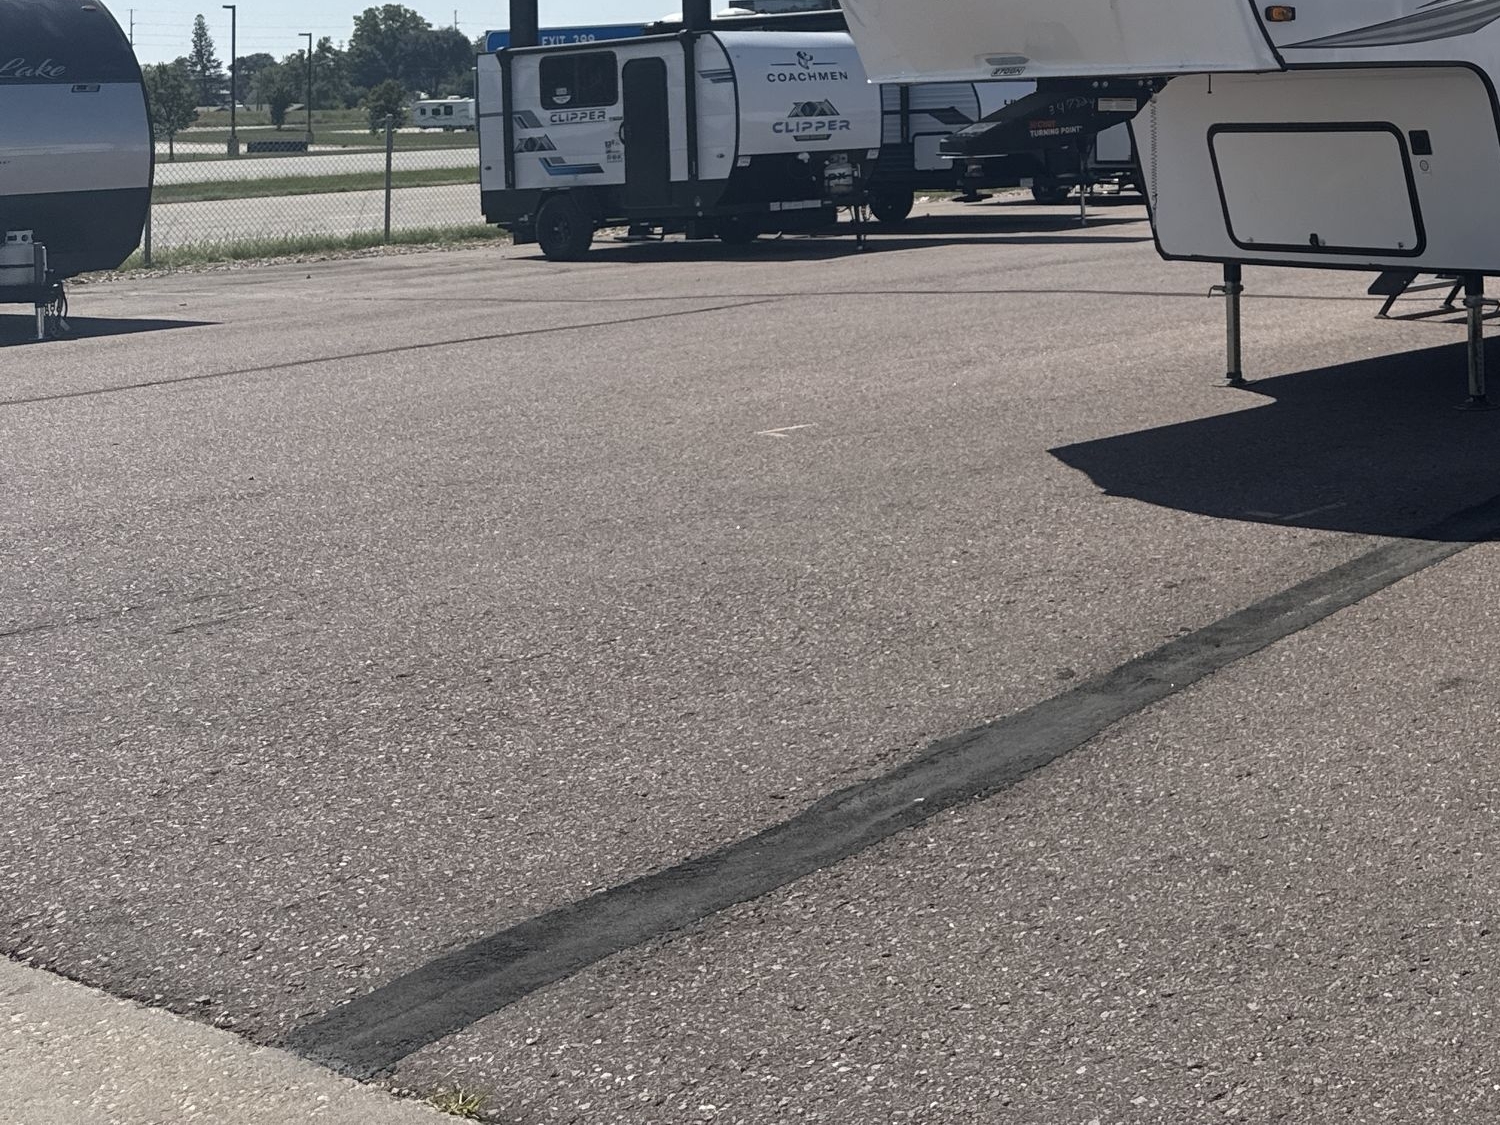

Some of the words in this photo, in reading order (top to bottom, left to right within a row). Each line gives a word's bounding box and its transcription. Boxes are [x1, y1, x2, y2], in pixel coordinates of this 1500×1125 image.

[542, 36, 566, 46] EXIT
[0, 57, 66, 79] Lake
[767, 71, 848, 82] COACHMEN
[550, 110, 606, 123] CLIPPER
[772, 120, 851, 133] CLIPPER
[1030, 128, 1060, 138] TURNING
[1061, 125, 1081, 135] POINT
